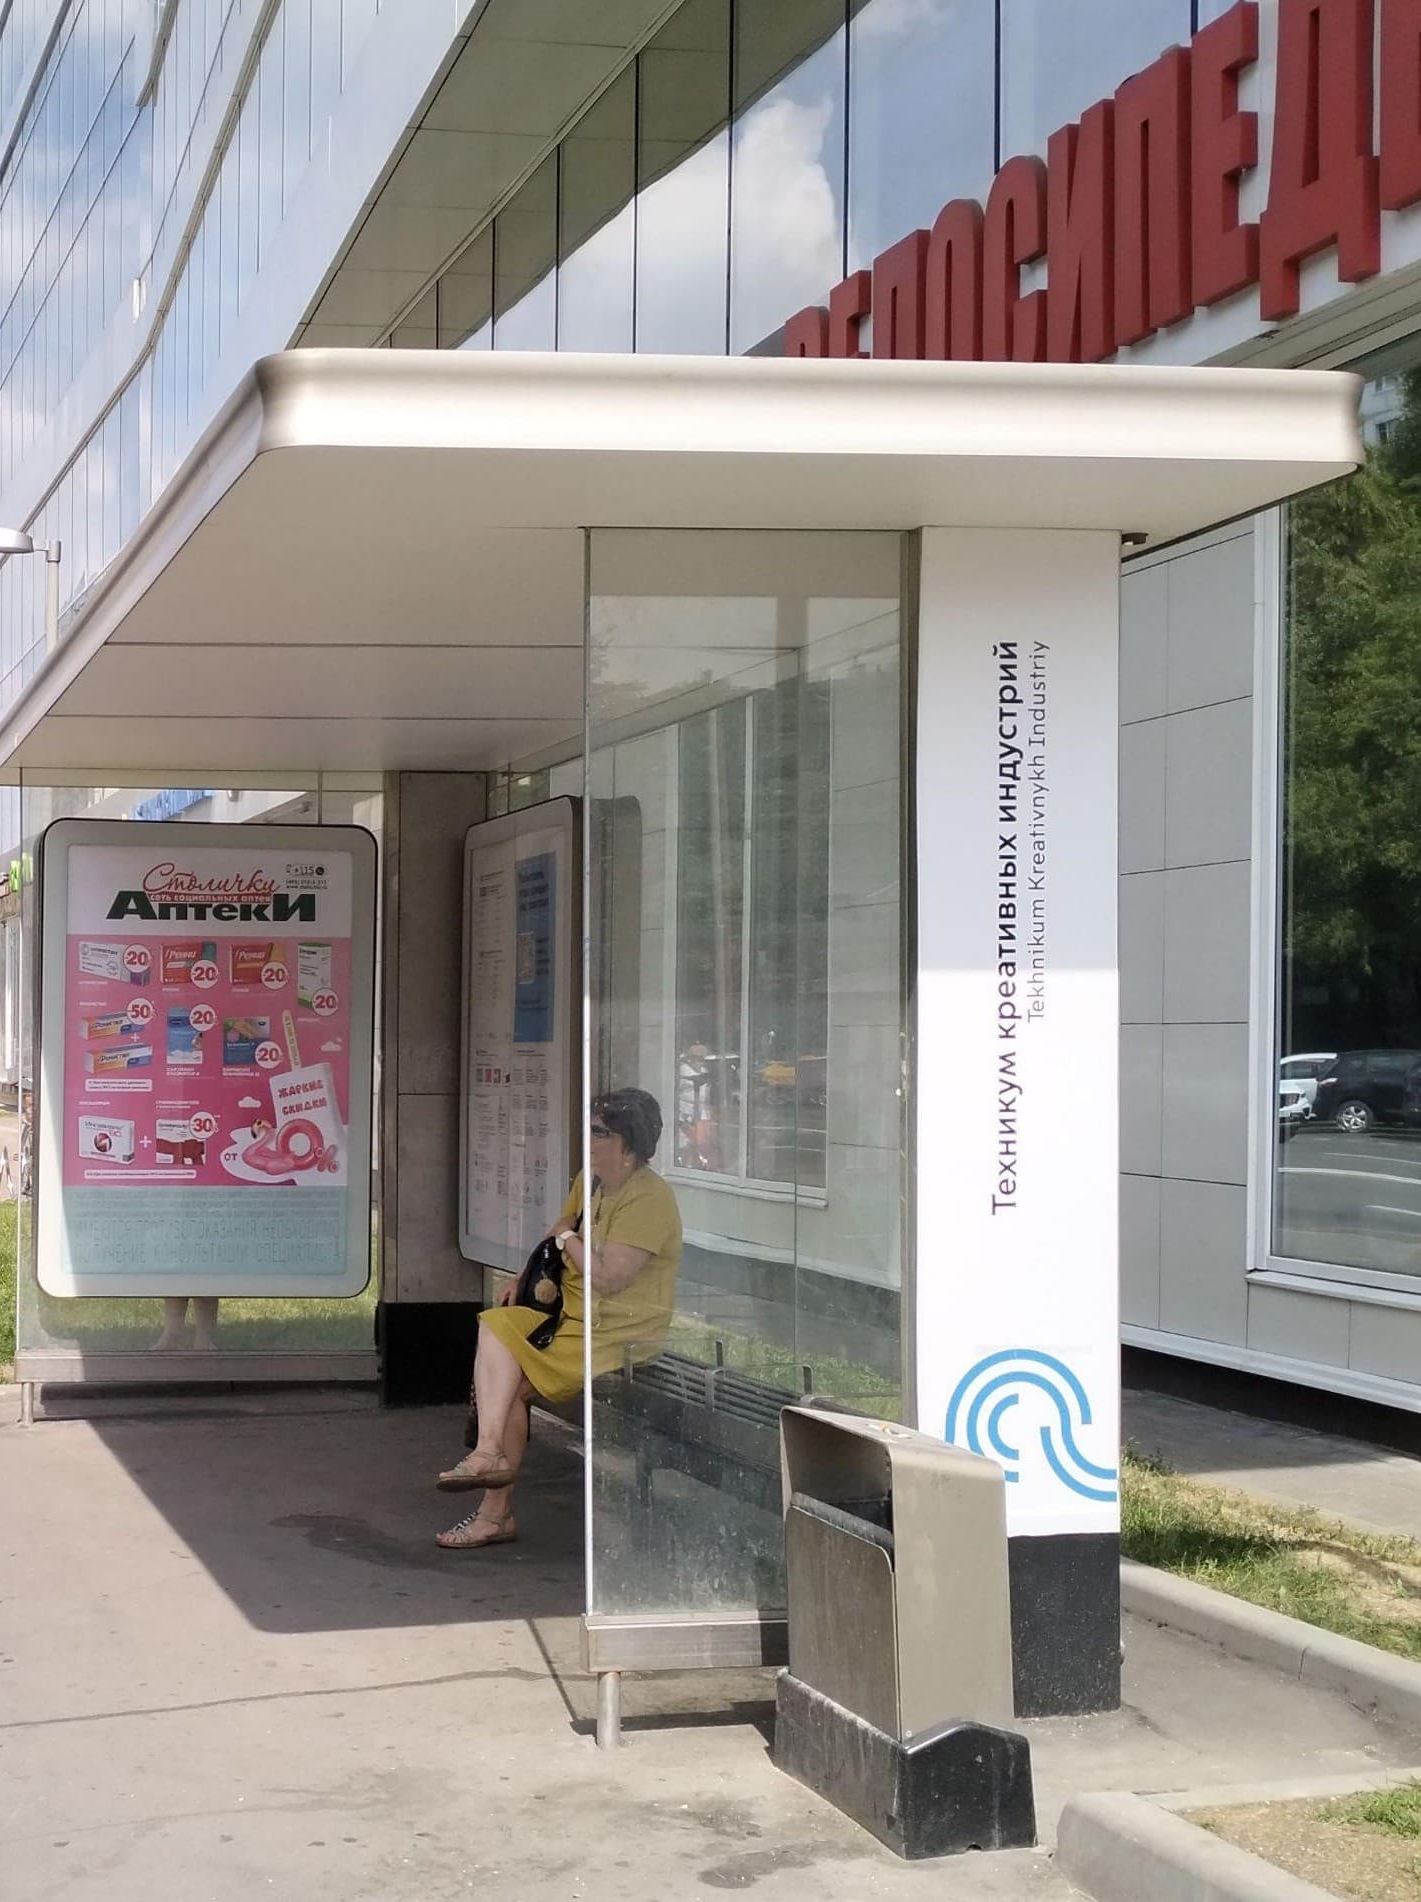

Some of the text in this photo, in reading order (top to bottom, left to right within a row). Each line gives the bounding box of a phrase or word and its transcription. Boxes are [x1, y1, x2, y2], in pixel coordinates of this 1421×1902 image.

[786, 0, 1421, 362] ЛОСИПЕД
[1027, 640, 1051, 1023] Tekhnikum Kreativnykh Industriy
[142, 862, 280, 893] Столички
[150, 893, 172, 902] сеть
[174, 894, 240, 903] социальных
[991, 641, 1024, 1216] Техникум креативных индустрий
[278, 1079, 324, 1098] ЖАРКИЕ
[281, 1097, 328, 1116] СКИДКИ
